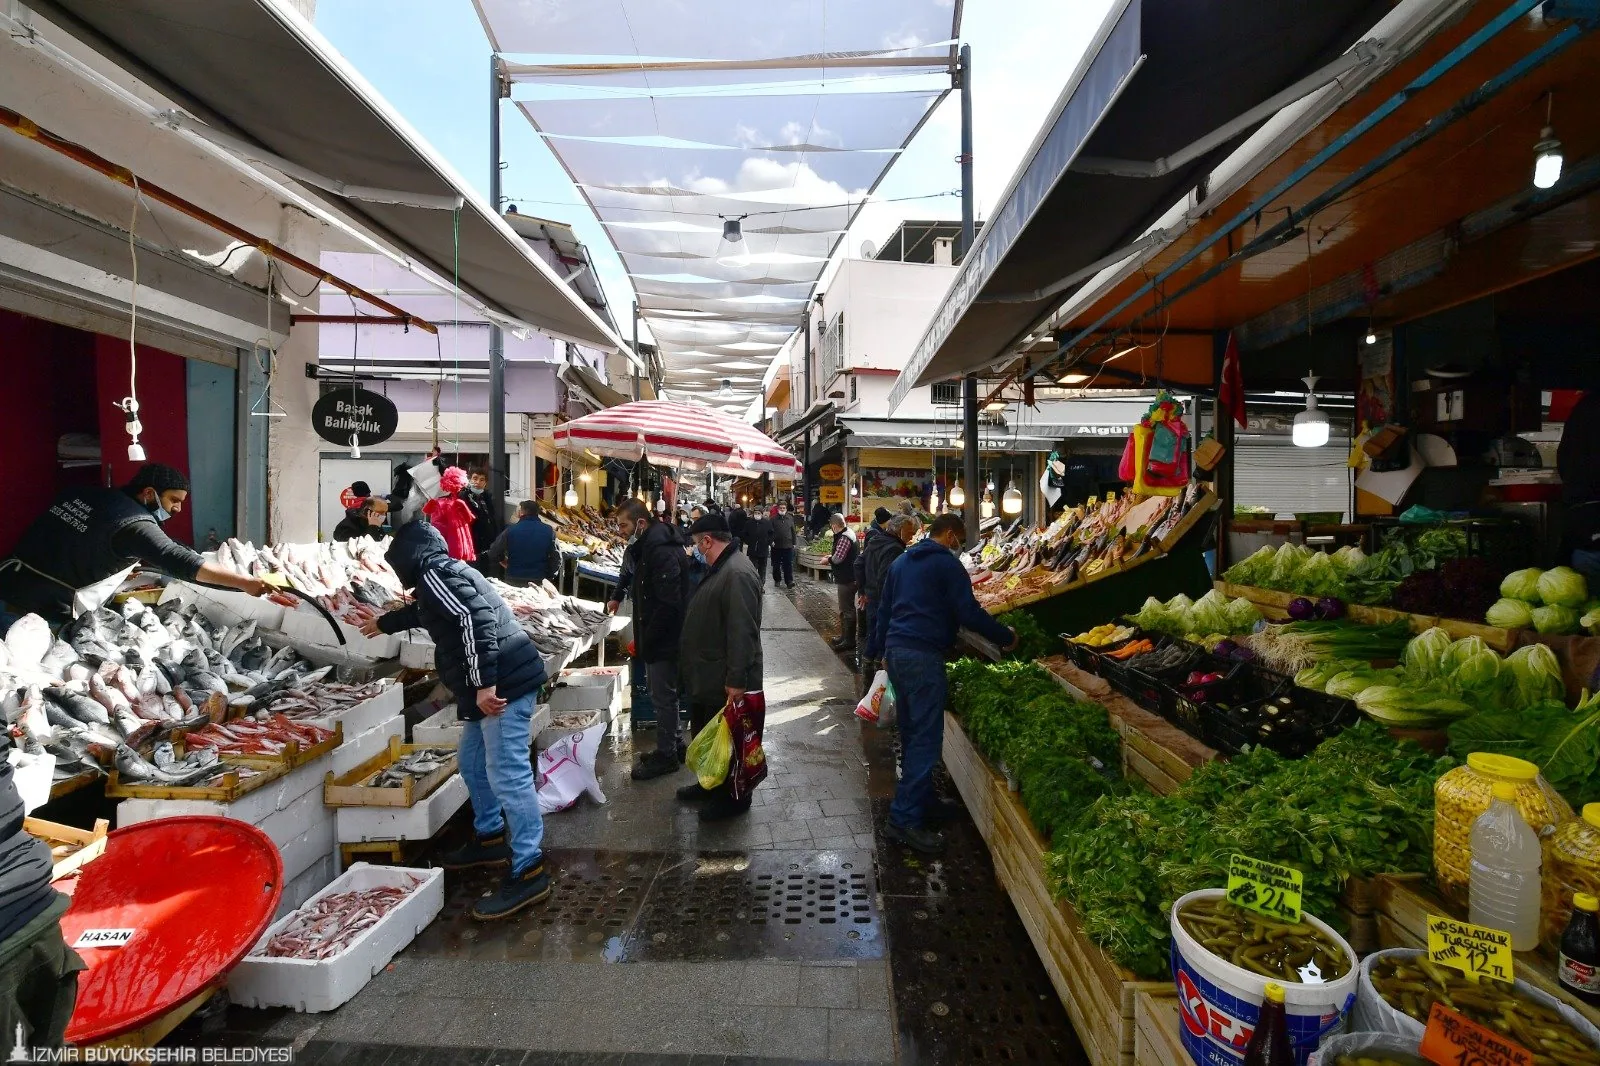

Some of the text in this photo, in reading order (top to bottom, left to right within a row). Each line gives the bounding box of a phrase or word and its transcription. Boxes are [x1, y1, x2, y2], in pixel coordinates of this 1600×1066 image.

[336, 400, 374, 416] Başak
[1077, 426, 1129, 436] Algül
[900, 437, 1007, 448] Köşe Mnav
[1256, 862, 1293, 880] ANKARA
[80, 931, 132, 942] HASAN
[1449, 923, 1508, 948] SALATALIK
[1466, 949, 1491, 974] 12
[1491, 964, 1508, 979] TL
[1208, 1051, 1235, 1066] akta
